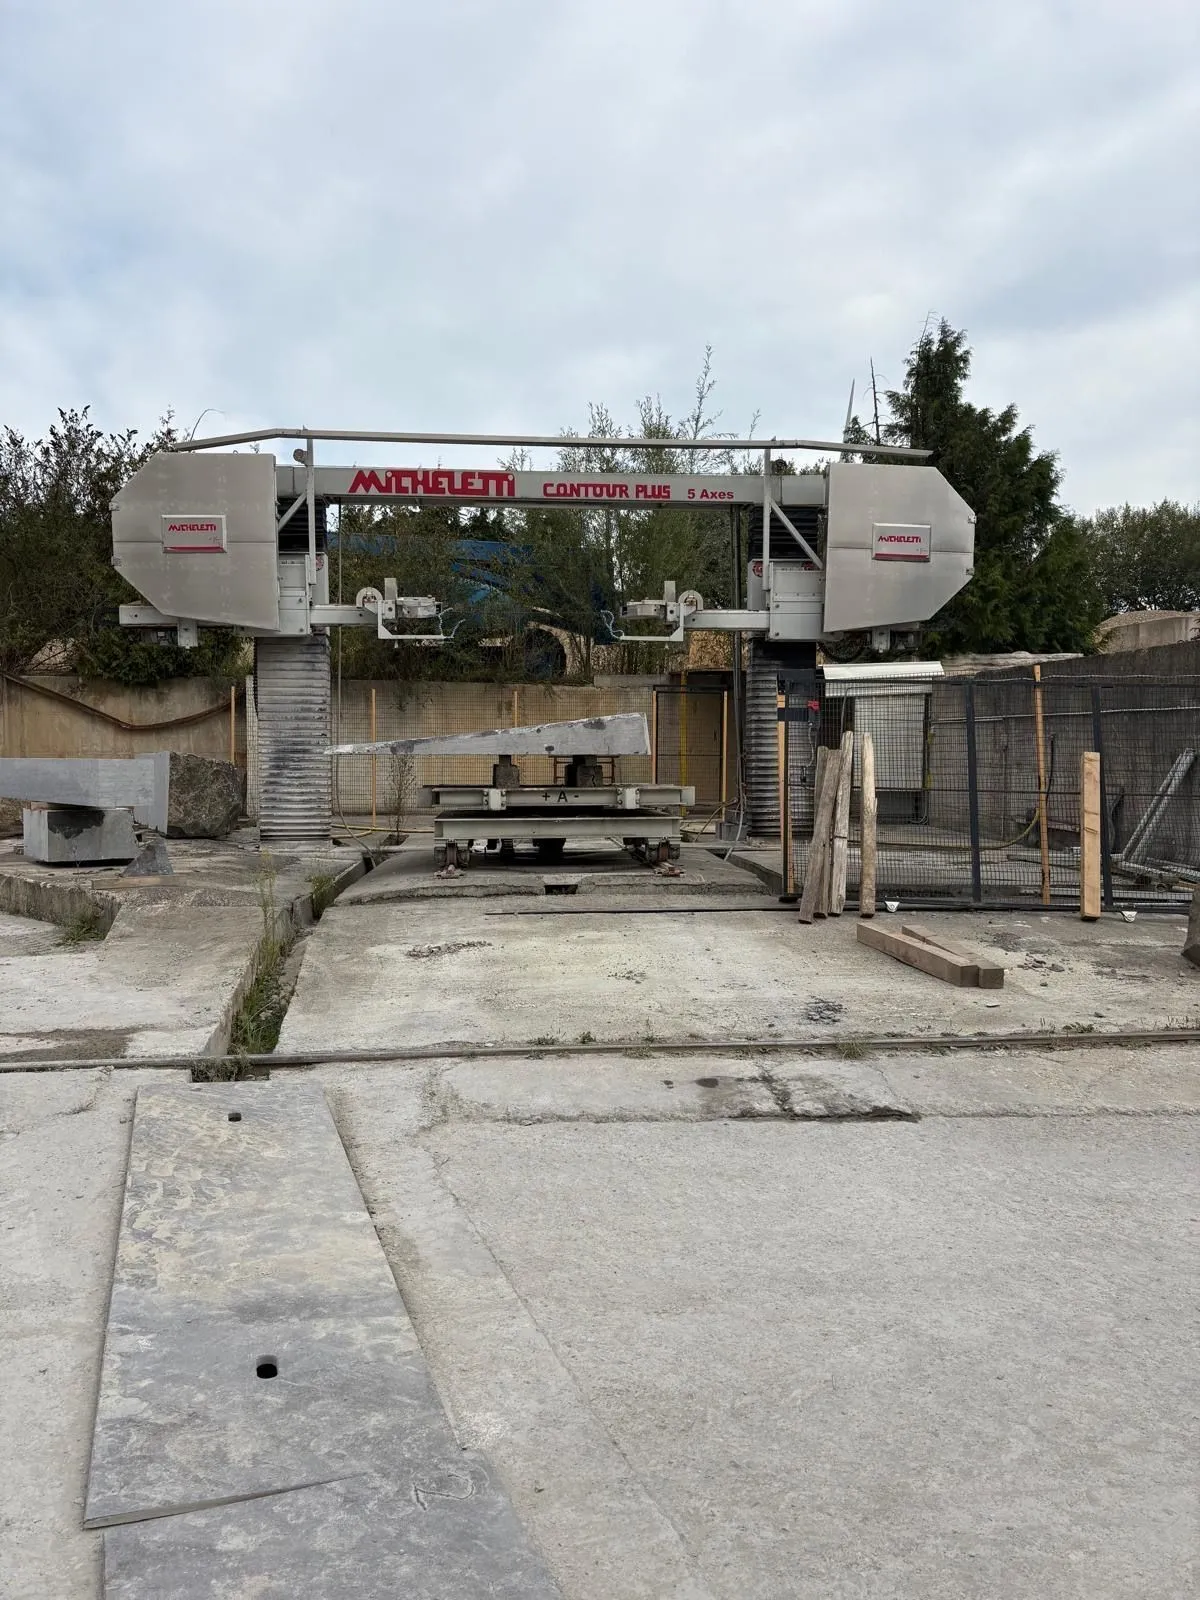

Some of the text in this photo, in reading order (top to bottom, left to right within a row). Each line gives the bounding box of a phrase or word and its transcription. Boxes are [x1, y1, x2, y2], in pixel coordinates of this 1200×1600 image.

[543, 483, 734, 500] CONTOUR PLUS 5 Axes
[557, 791, 568, 803] A
